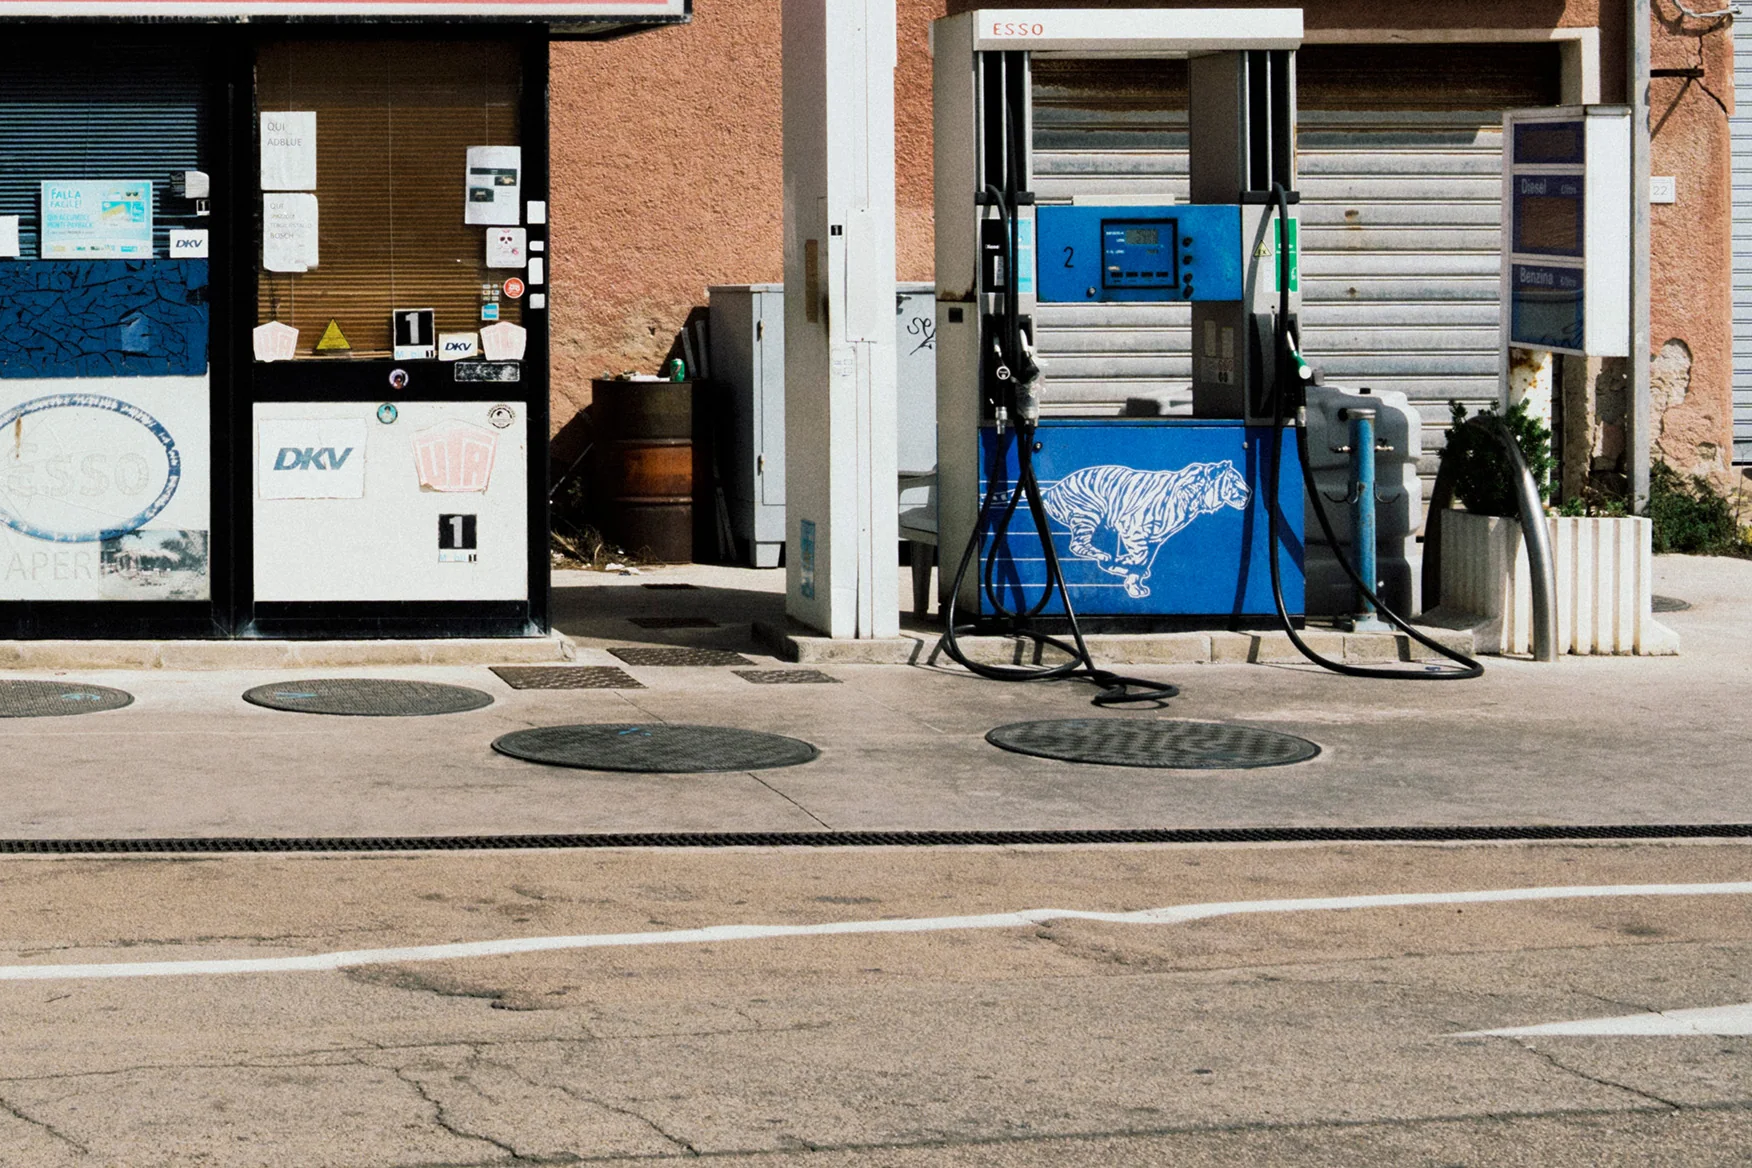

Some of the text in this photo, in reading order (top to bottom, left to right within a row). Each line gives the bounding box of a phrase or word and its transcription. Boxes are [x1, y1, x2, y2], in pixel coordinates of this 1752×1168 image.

[993, 22, 1043, 36] ESSO
[267, 122, 285, 132] QUI
[267, 138, 302, 146] ADBLUE
[1521, 179, 1546, 194] Diesel
[1653, 186, 1667, 195] 22
[176, 240, 202, 248] DKV
[1064, 247, 1074, 268] 2
[1520, 268, 1553, 284] Benzina
[405, 312, 420, 344] 1
[445, 342, 472, 351] DKV
[273, 447, 354, 471] DKV
[449, 516, 463, 548] 1
